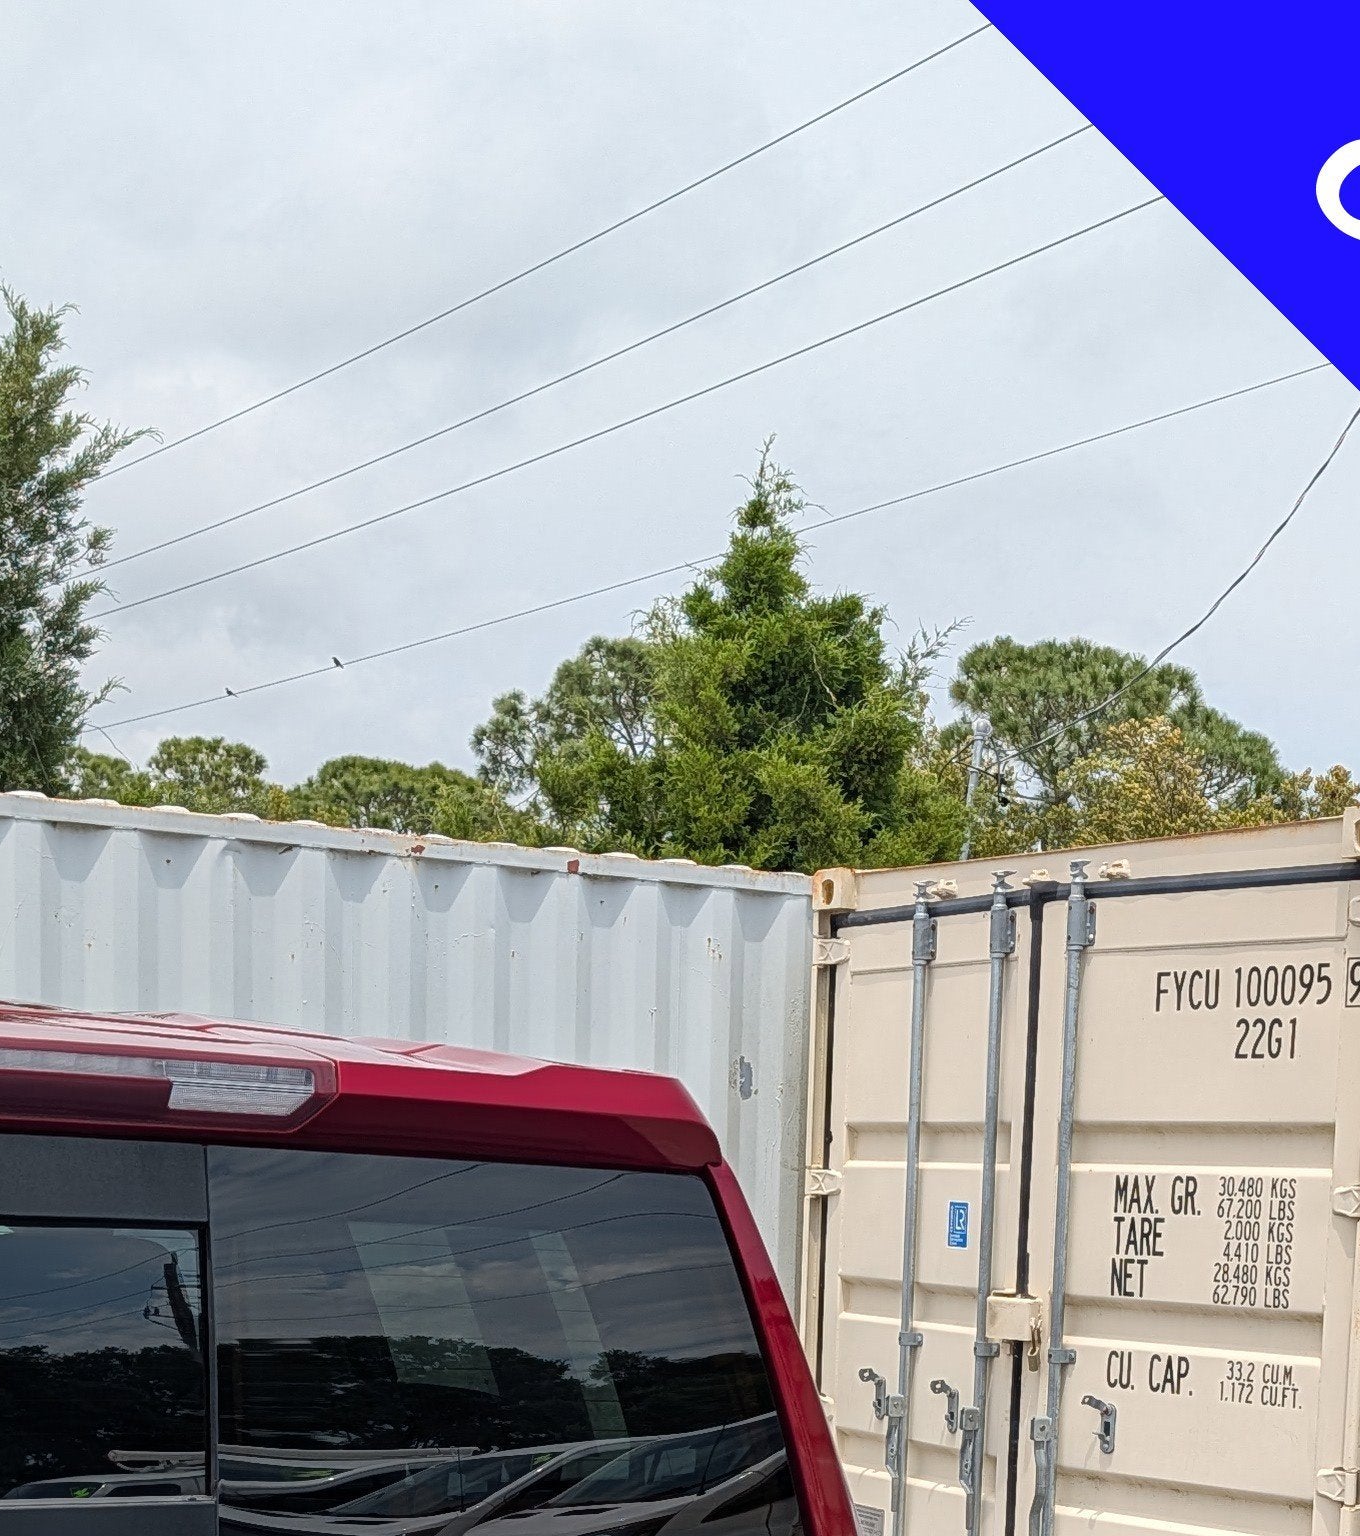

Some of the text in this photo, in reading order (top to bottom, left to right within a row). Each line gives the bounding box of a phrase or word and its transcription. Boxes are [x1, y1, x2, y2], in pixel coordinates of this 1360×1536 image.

[1155, 969, 1220, 1012] FYCU
[1235, 963, 1332, 1007] 100095
[1234, 1017, 1297, 1059] 22G1
[1114, 1175, 1159, 1214] MAX.
[1171, 1175, 1201, 1216] GR.
[1270, 1178, 1297, 1199] KGS
[1269, 1200, 1295, 1221] LBS
[1114, 1216, 1165, 1256] TARE
[1267, 1222, 1294, 1243] KGS
[1266, 1243, 1292, 1265] LBS
[1110, 1258, 1148, 1298] NET
[1265, 1265, 1290, 1287] KGS
[1264, 1288, 1289, 1309] LBS
[1106, 1350, 1135, 1390] CU.
[1148, 1354, 1193, 1396] CAP.
[1226, 1360, 1255, 1382] 33.2
